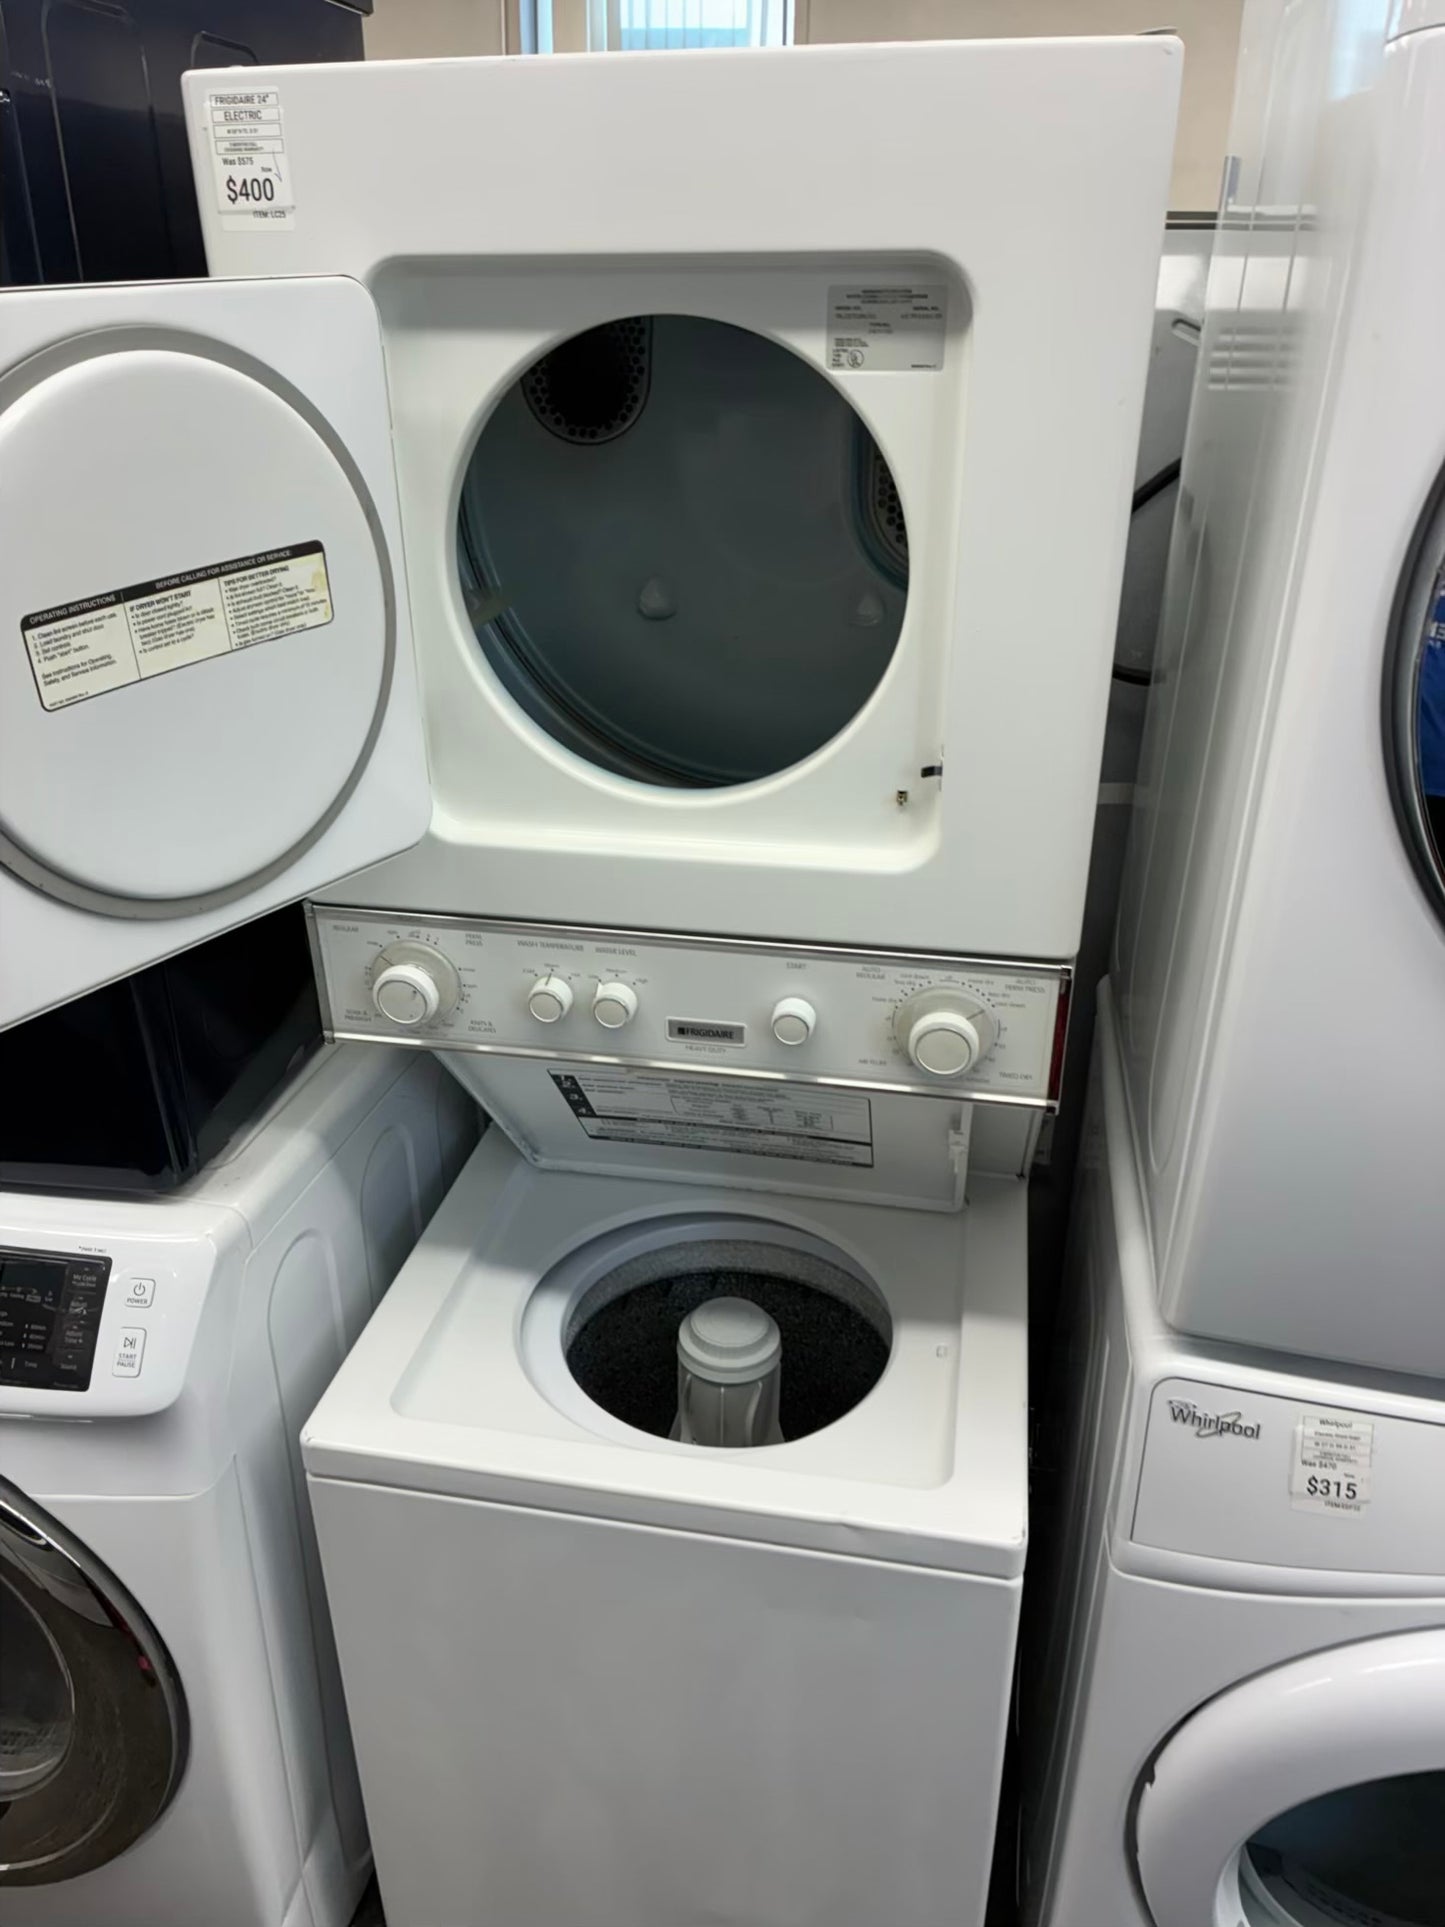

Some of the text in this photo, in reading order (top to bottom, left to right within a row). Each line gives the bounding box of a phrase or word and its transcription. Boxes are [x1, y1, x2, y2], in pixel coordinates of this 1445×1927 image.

[214, 95, 255, 105] FRIGIDAIRE
[224, 110, 262, 121] ELECTRIC
[222, 158, 236, 166] Was
[226, 175, 275, 205] $400
[155, 576, 179, 589] BEFORE
[180, 569, 206, 582] CALLING
[207, 566, 219, 575] FOR
[220, 557, 255, 572] ASSISTANCE
[256, 555, 265, 563] OR
[135, 599, 155, 610] DRYER
[174, 590, 190, 600] START
[29, 594, 115, 624] OPERATING INSTRUCTIONS
[539, 941, 584, 951] TEMPERATURE
[618, 948, 637, 957] LEVEL
[686, 1028, 735, 1040] FRIGIDAIRE
[127, 1297, 148, 1305] POWER
[117, 1360, 136, 1368] PAUSE
[1169, 1404, 1262, 1440] Whirlpool
[1306, 1475, 1357, 1500] $315
